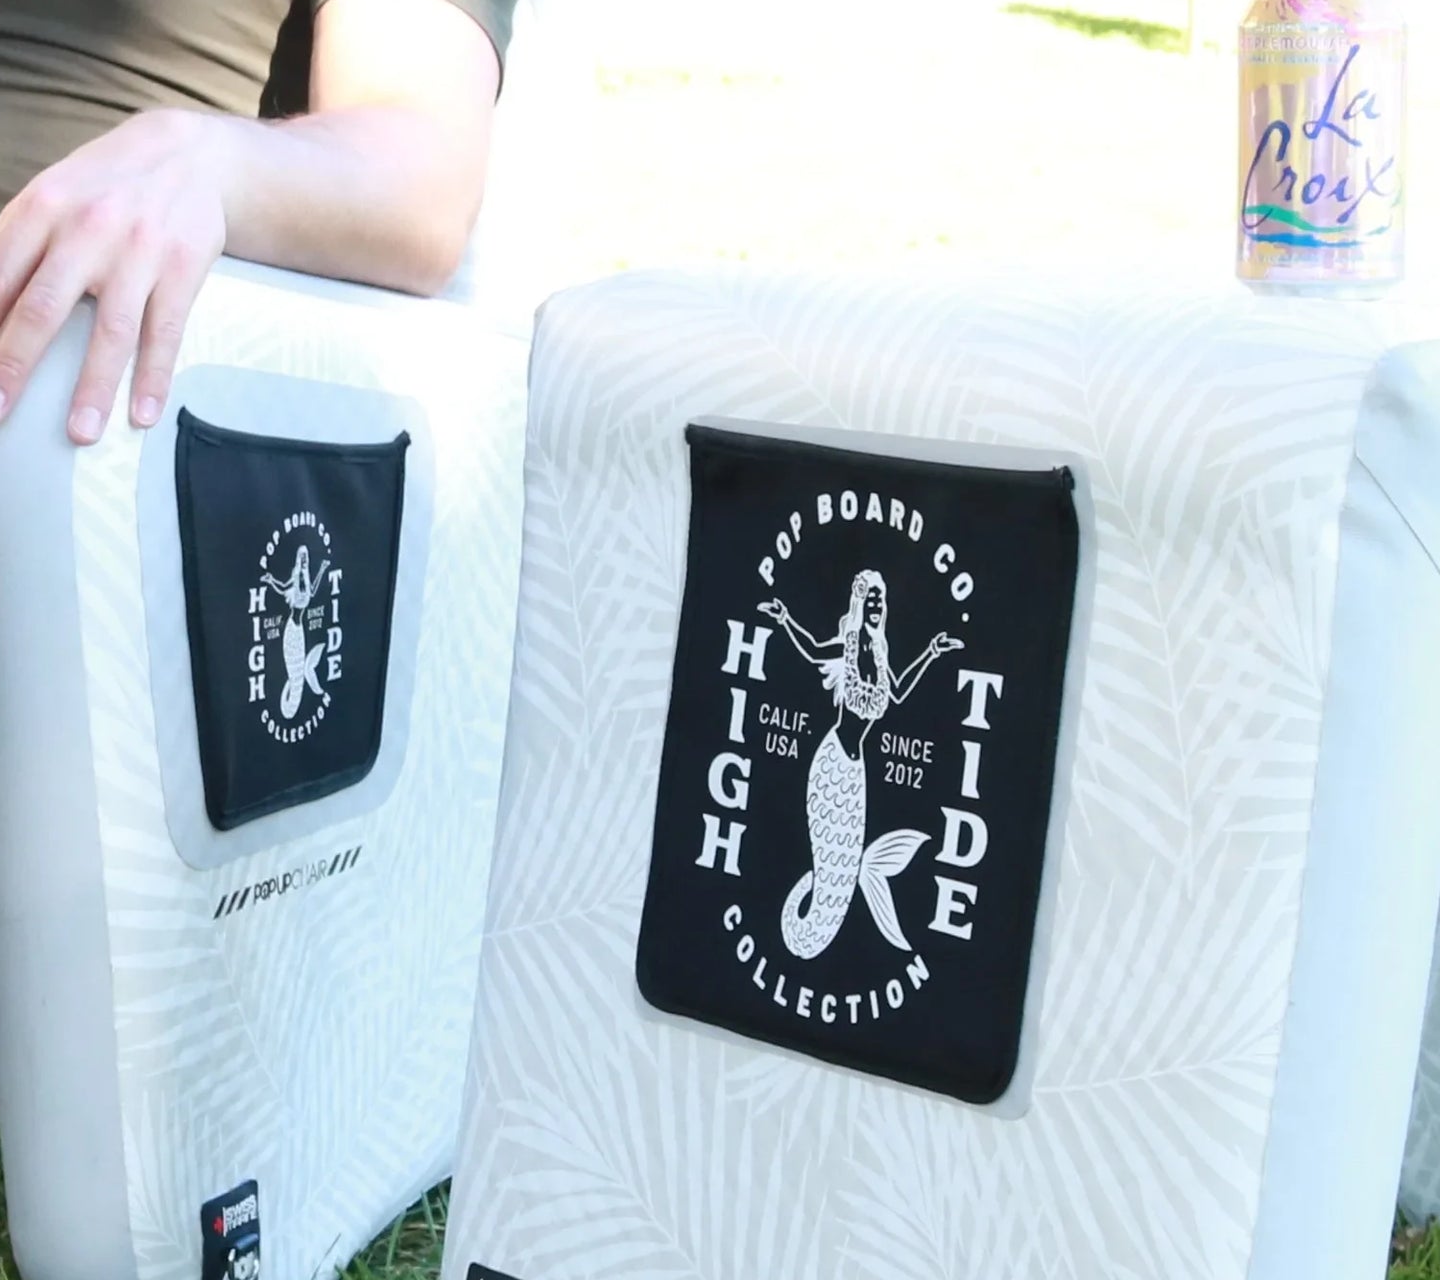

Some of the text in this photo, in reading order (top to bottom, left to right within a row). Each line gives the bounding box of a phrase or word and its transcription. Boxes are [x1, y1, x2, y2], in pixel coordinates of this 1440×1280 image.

[1303, 43, 1381, 147] La
[1241, 119, 1394, 230] Croix
[259, 530, 280, 570] POP
[759, 490, 974, 622] POP BOARD CO.
[248, 586, 268, 703] HIGH
[326, 569, 343, 682] TIDE
[260, 692, 332, 744] COLLECTION
[695, 619, 774, 877] HIGH
[759, 703, 812, 735] CALIF.
[765, 732, 799, 760] USA
[880, 732, 934, 763] SINCE
[884, 761, 924, 789] 2012
[922, 669, 1004, 940] TIDE
[723, 904, 930, 1024] COLLECTION
